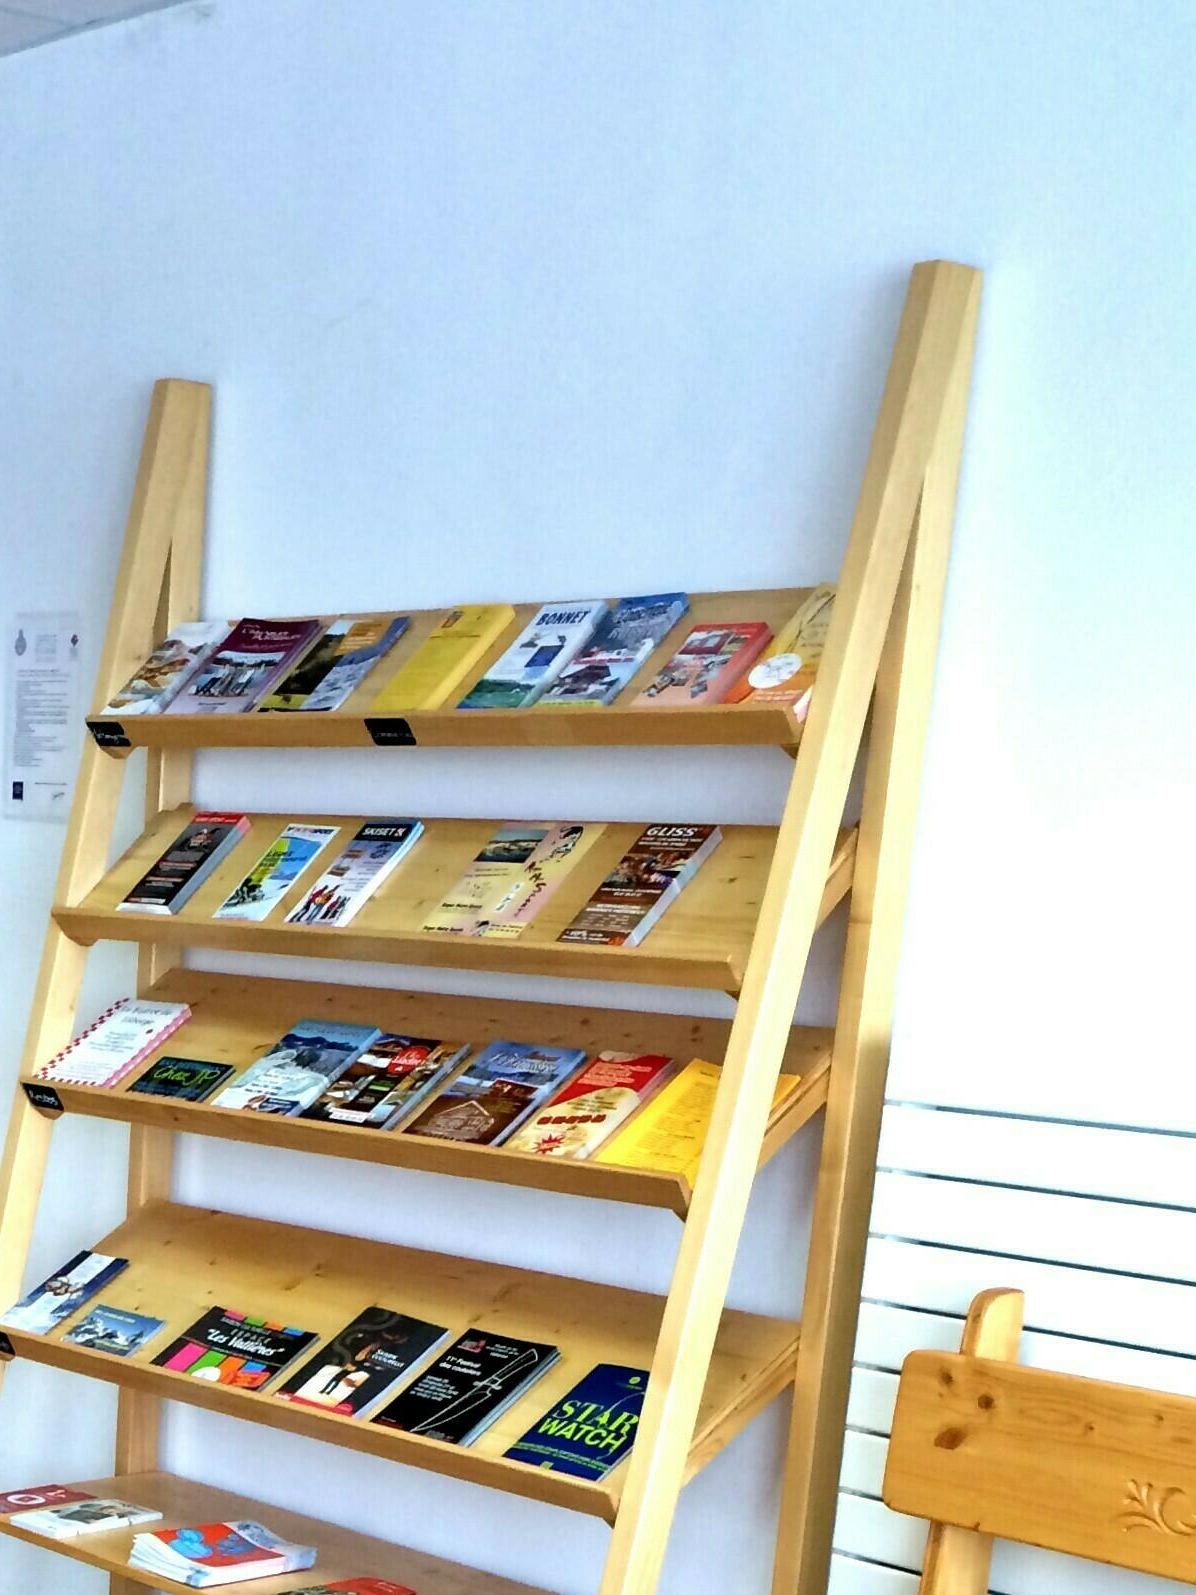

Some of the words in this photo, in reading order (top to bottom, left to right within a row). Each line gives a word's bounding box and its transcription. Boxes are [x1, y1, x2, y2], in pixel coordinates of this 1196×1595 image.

[536, 609, 593, 626] BONNET
[362, 827, 396, 838] SKISET
[646, 826, 697, 837] GLISS
[552, 1400, 640, 1434] STAR
[537, 1418, 628, 1450] WATCH
